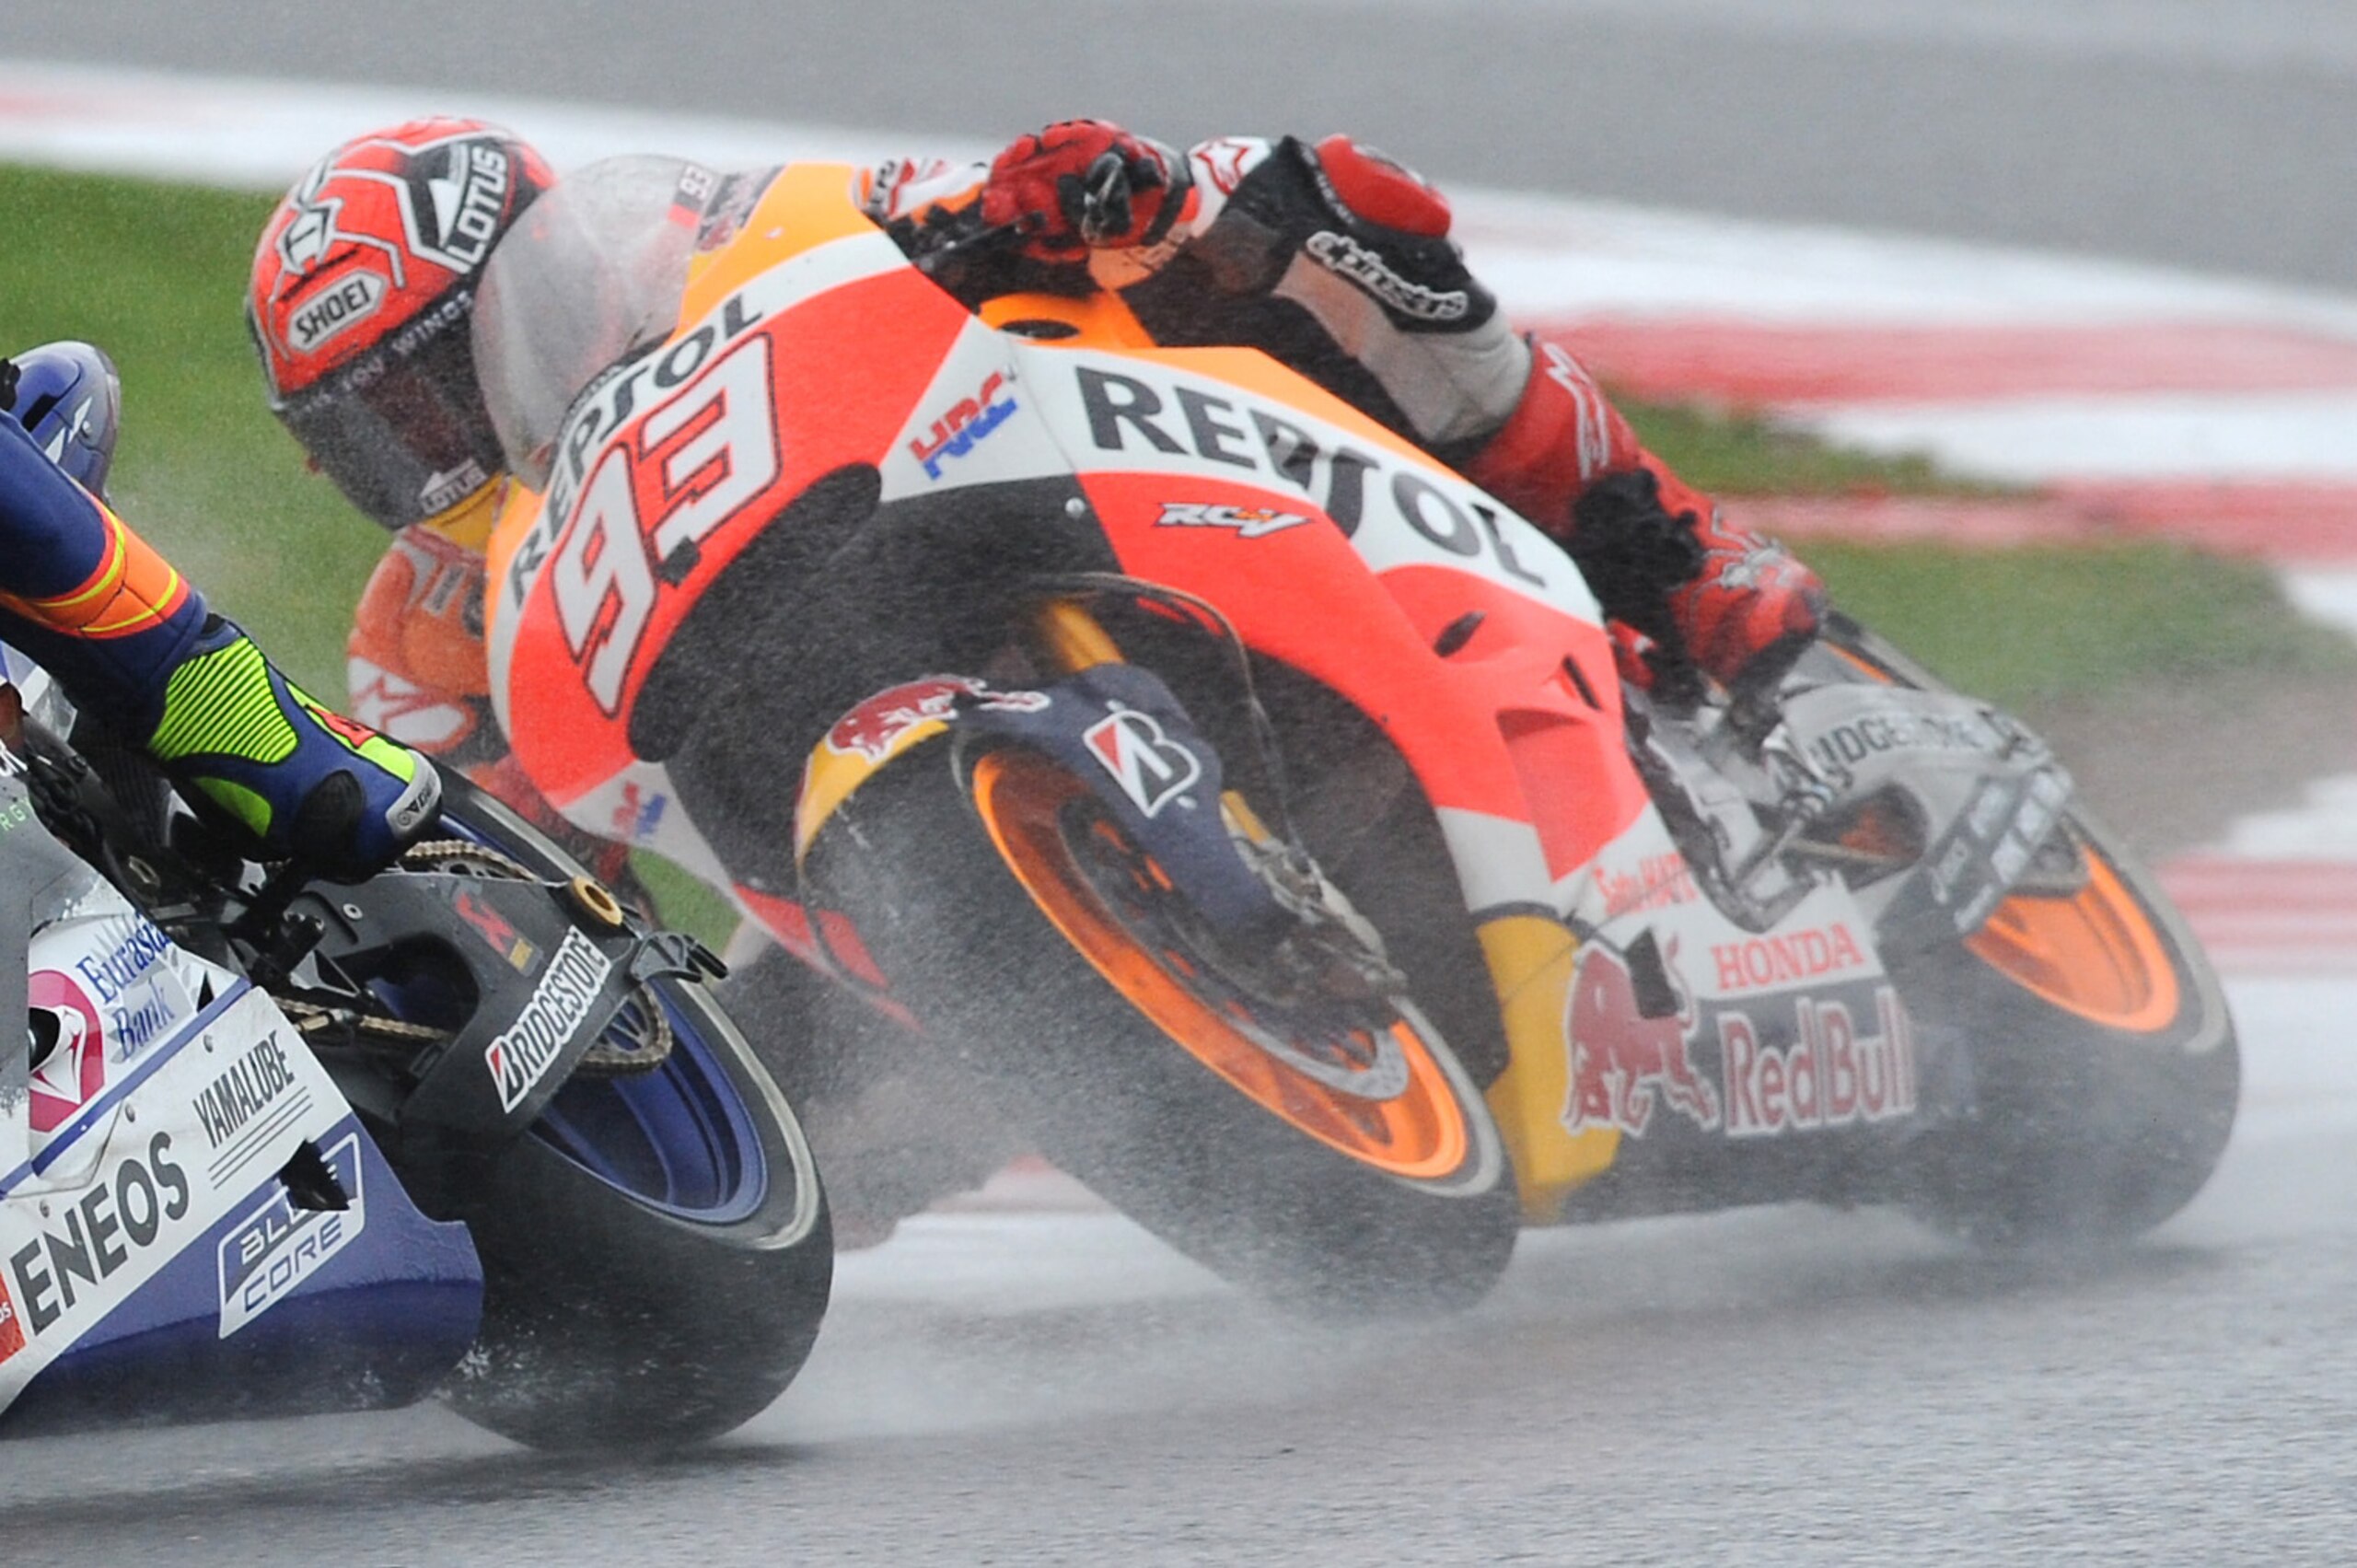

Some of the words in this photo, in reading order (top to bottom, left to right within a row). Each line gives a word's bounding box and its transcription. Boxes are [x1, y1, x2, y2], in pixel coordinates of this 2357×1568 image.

[446, 145, 507, 265] LOTUS
[679, 166, 714, 202] 93
[296, 279, 370, 343] SHOEI
[509, 292, 763, 611] REPSOL
[551, 331, 784, 721] 93
[1711, 923, 1865, 992] HONDA
[112, 977, 175, 1059] Bank
[192, 1029, 295, 1149] YAMALUBE
[10, 1132, 189, 1336] ENEOS
[244, 1214, 343, 1313] CORE
